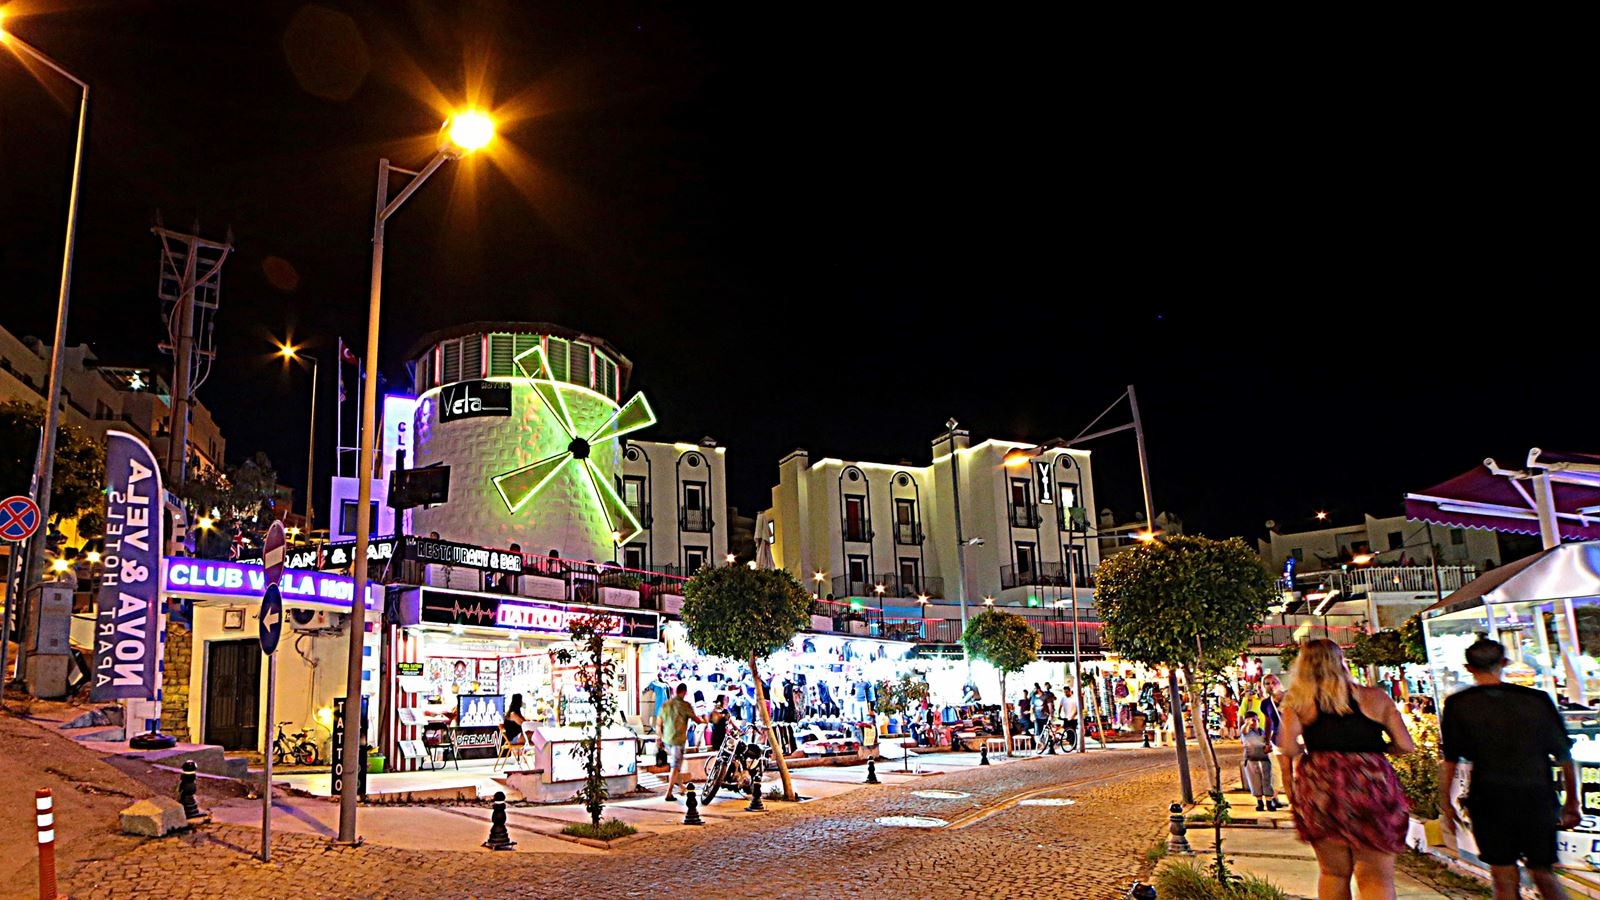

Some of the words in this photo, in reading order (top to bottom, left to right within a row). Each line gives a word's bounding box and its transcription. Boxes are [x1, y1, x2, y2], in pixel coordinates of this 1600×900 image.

[417, 540, 490, 567] RESTAURANT
[490, 552, 499, 569] &
[500, 553, 522, 572] BAR
[169, 564, 243, 588] CLUB
[335, 701, 344, 791] TATTOO
